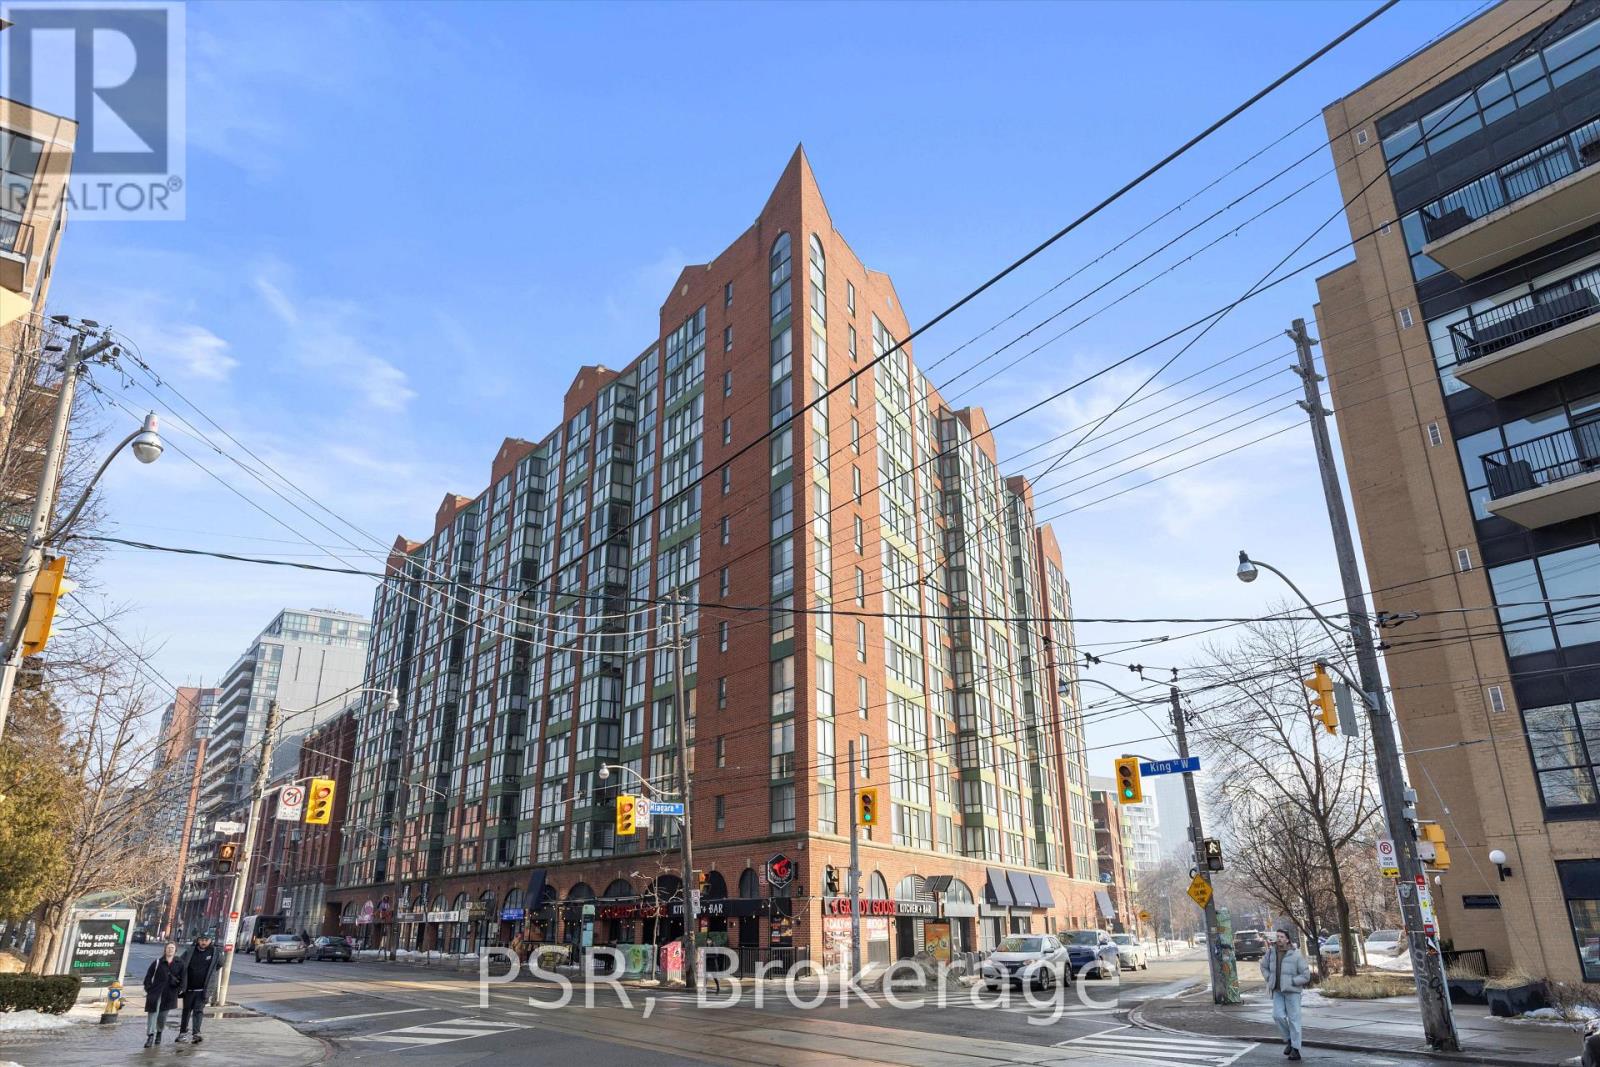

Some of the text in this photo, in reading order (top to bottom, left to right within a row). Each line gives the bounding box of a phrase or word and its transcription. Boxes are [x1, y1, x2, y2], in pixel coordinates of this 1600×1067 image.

[1150, 762, 1172, 773] King
[1180, 759, 1189, 769] W
[650, 803, 674, 814] Niagara
[709, 903, 723, 914] BAR
[840, 898, 870, 916] GRDY
[872, 899, 897, 916] GOOSE
[95, 933, 119, 941] speak
[76, 948, 116, 957] language.
[74, 960, 111, 968] Business.
